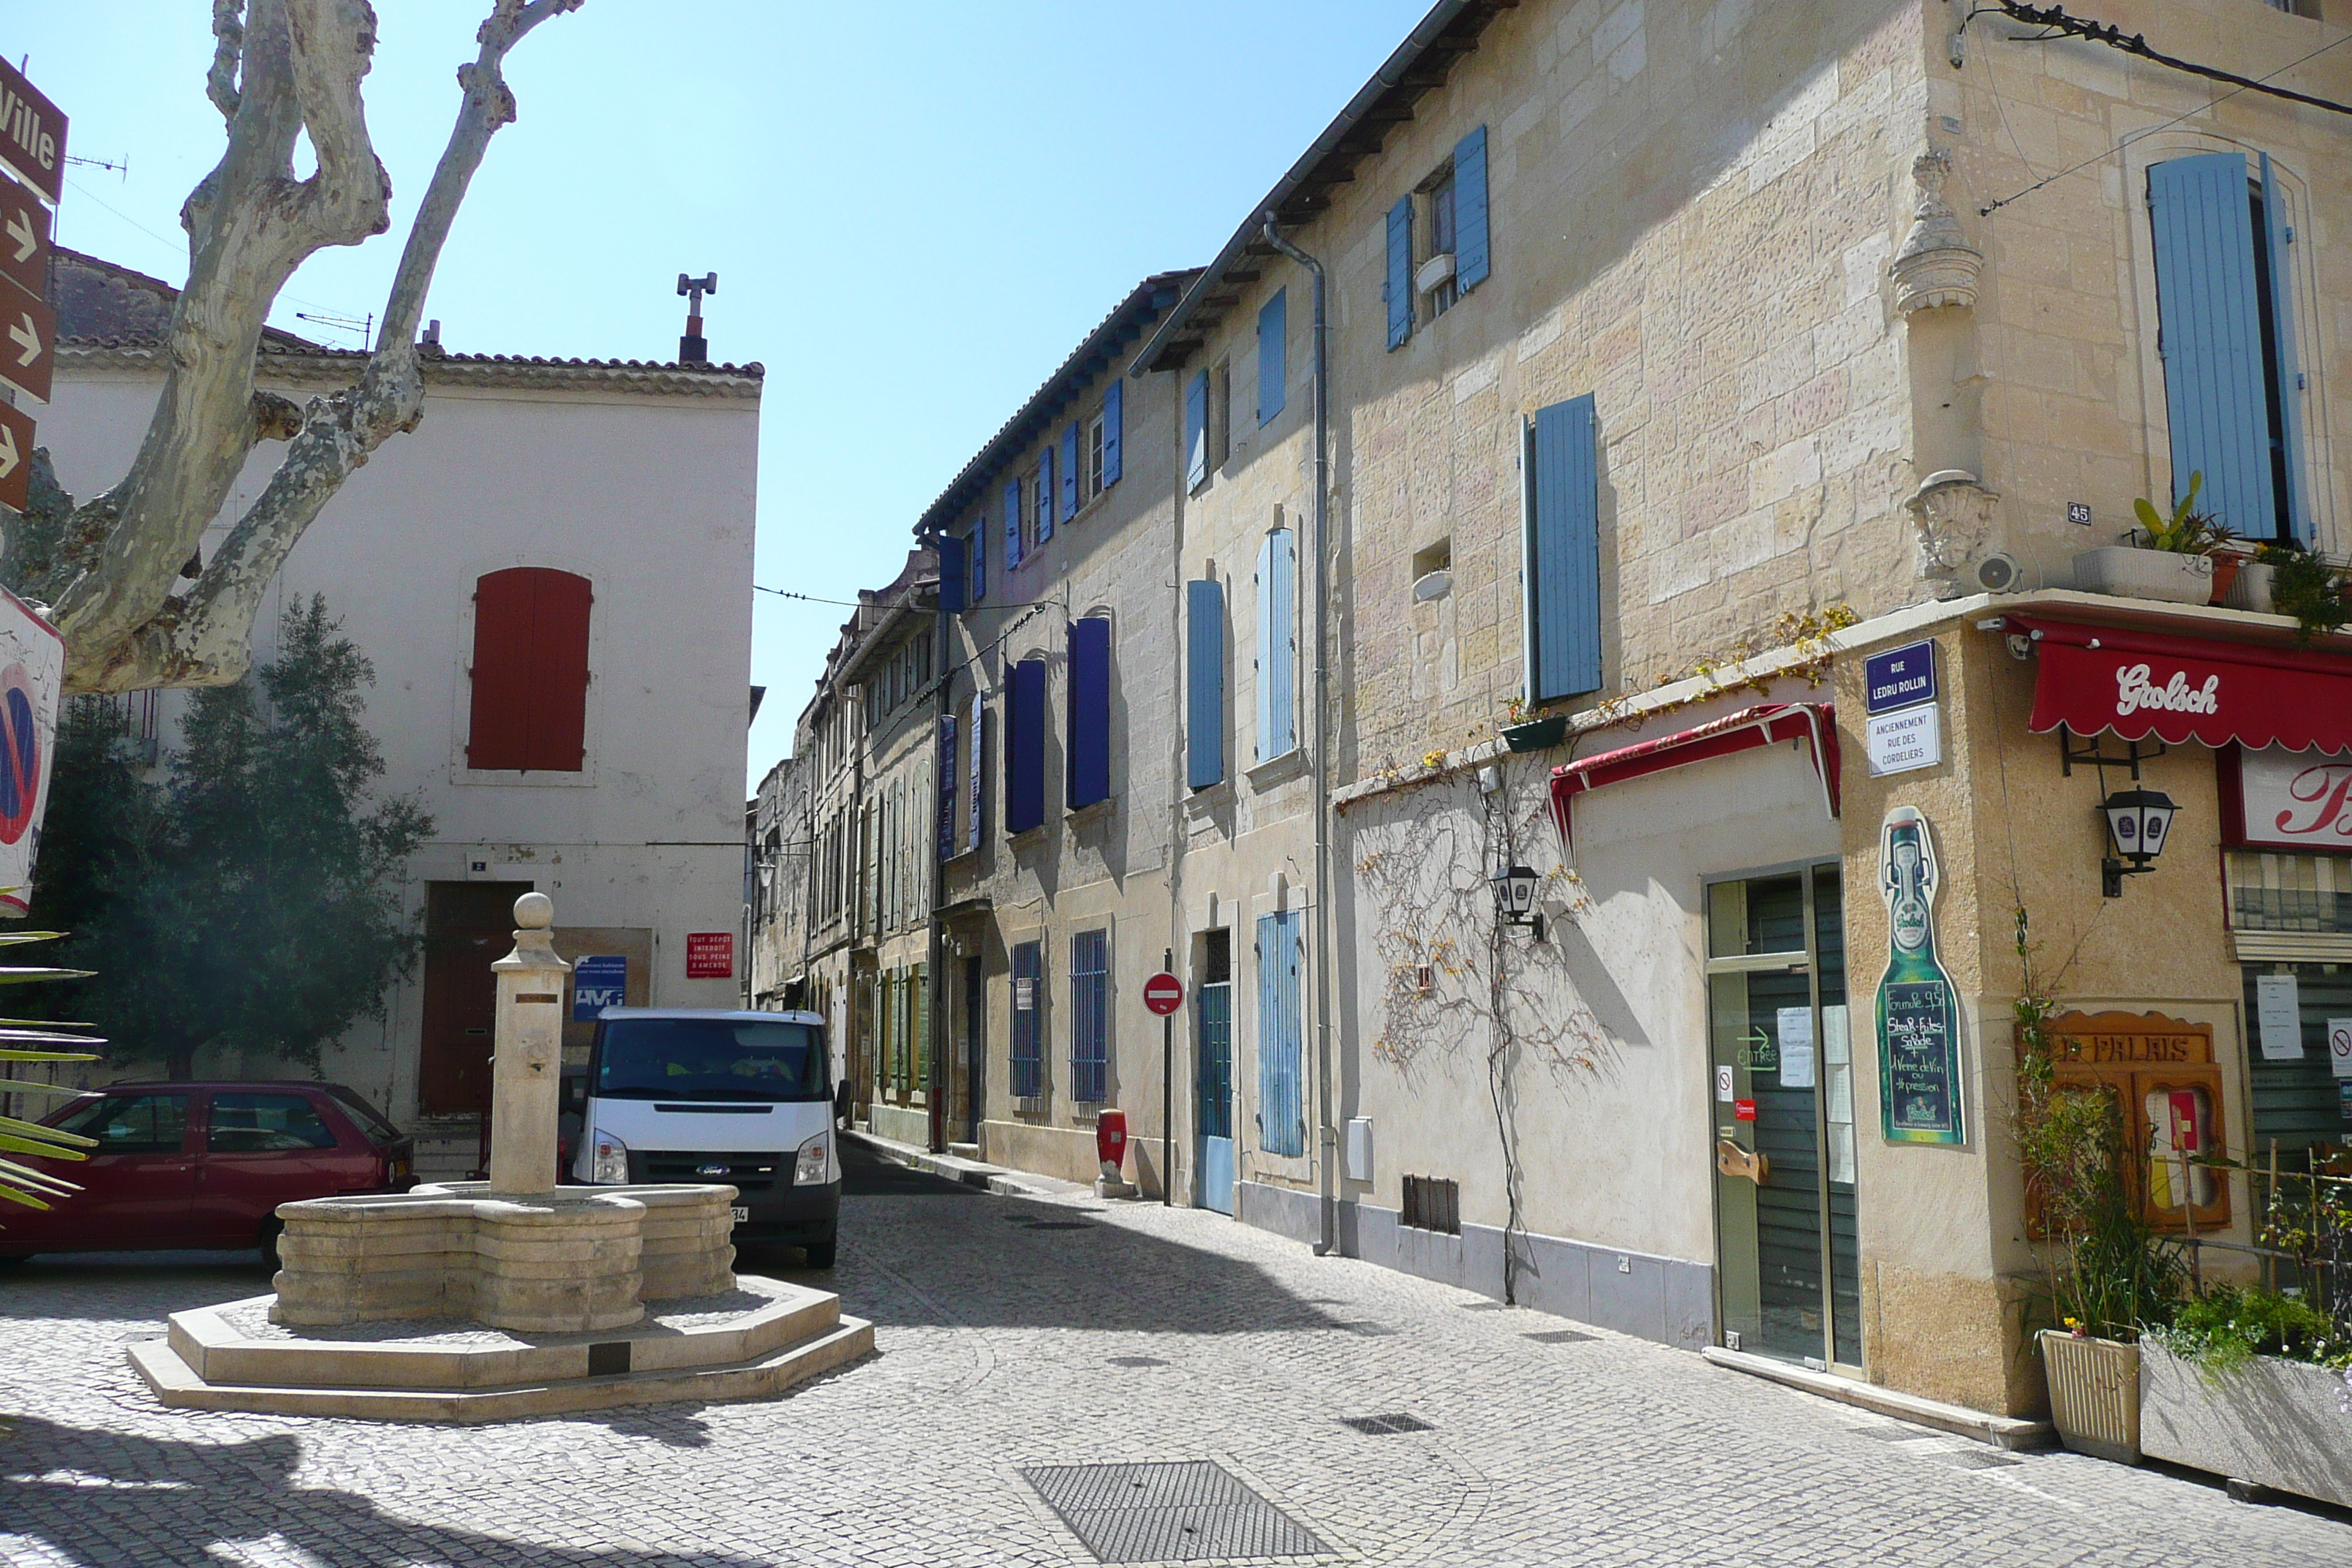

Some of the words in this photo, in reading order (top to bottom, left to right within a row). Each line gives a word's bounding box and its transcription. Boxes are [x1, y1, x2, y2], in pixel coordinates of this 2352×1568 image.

[0, 79, 55, 170] Ville
[2071, 506, 2088, 521] 45
[1891, 660, 1905, 674] RUE
[1873, 682, 1897, 700] LEDRU
[1899, 675, 1927, 694] ROLLIN
[2116, 663, 2219, 716] Grolsch
[1876, 715, 1927, 736] ANCIENNEMENT
[1888, 736, 1901, 749] RUE
[1902, 734, 1916, 746] DES
[1882, 747, 1924, 766] CORDELIERS
[1888, 990, 1923, 1011] Formule
[1901, 1032, 1934, 1047] Salade
[2094, 1036, 2189, 1062] PALAIS
